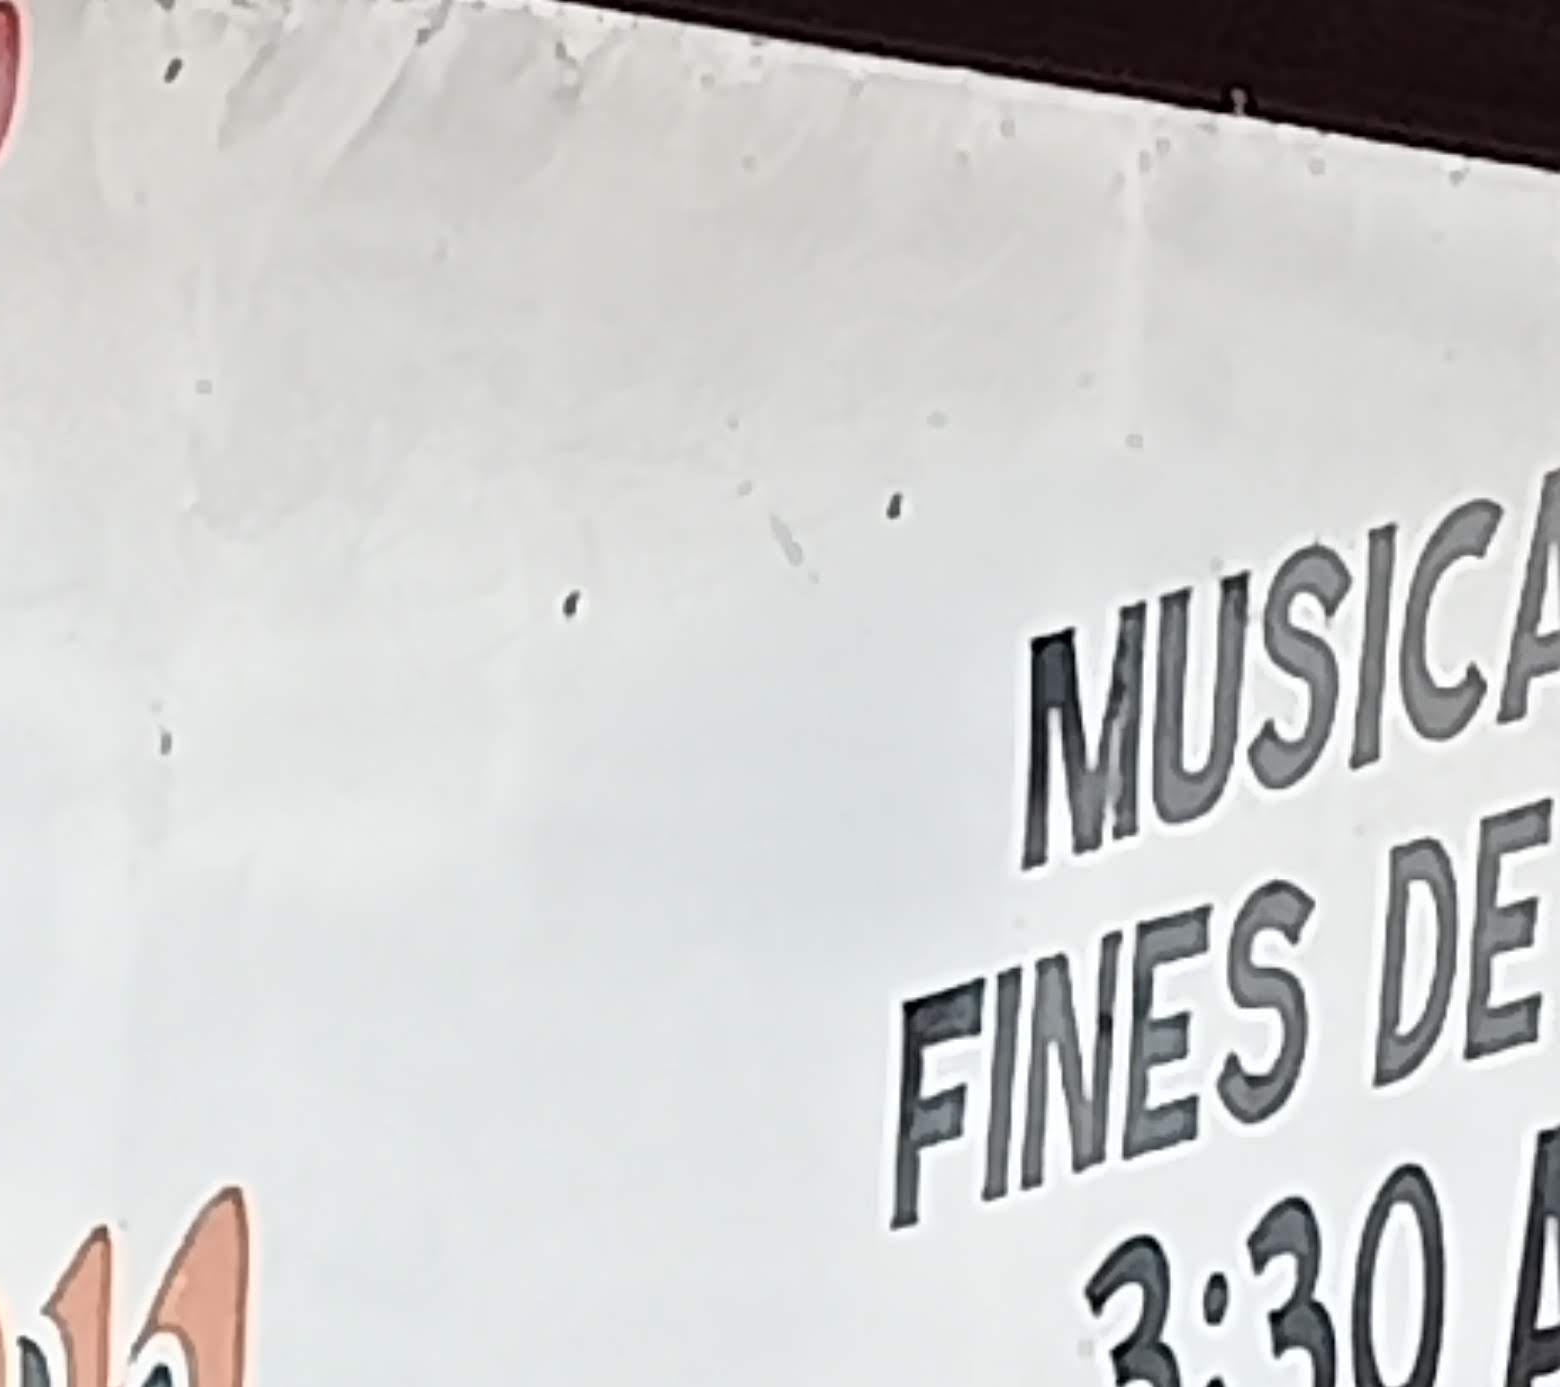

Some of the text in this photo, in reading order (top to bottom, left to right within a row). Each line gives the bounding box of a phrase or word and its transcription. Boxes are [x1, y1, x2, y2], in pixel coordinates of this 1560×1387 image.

[1021, 468, 1560, 869] MUSICA
[890, 799, 1553, 1230] FINES DE
